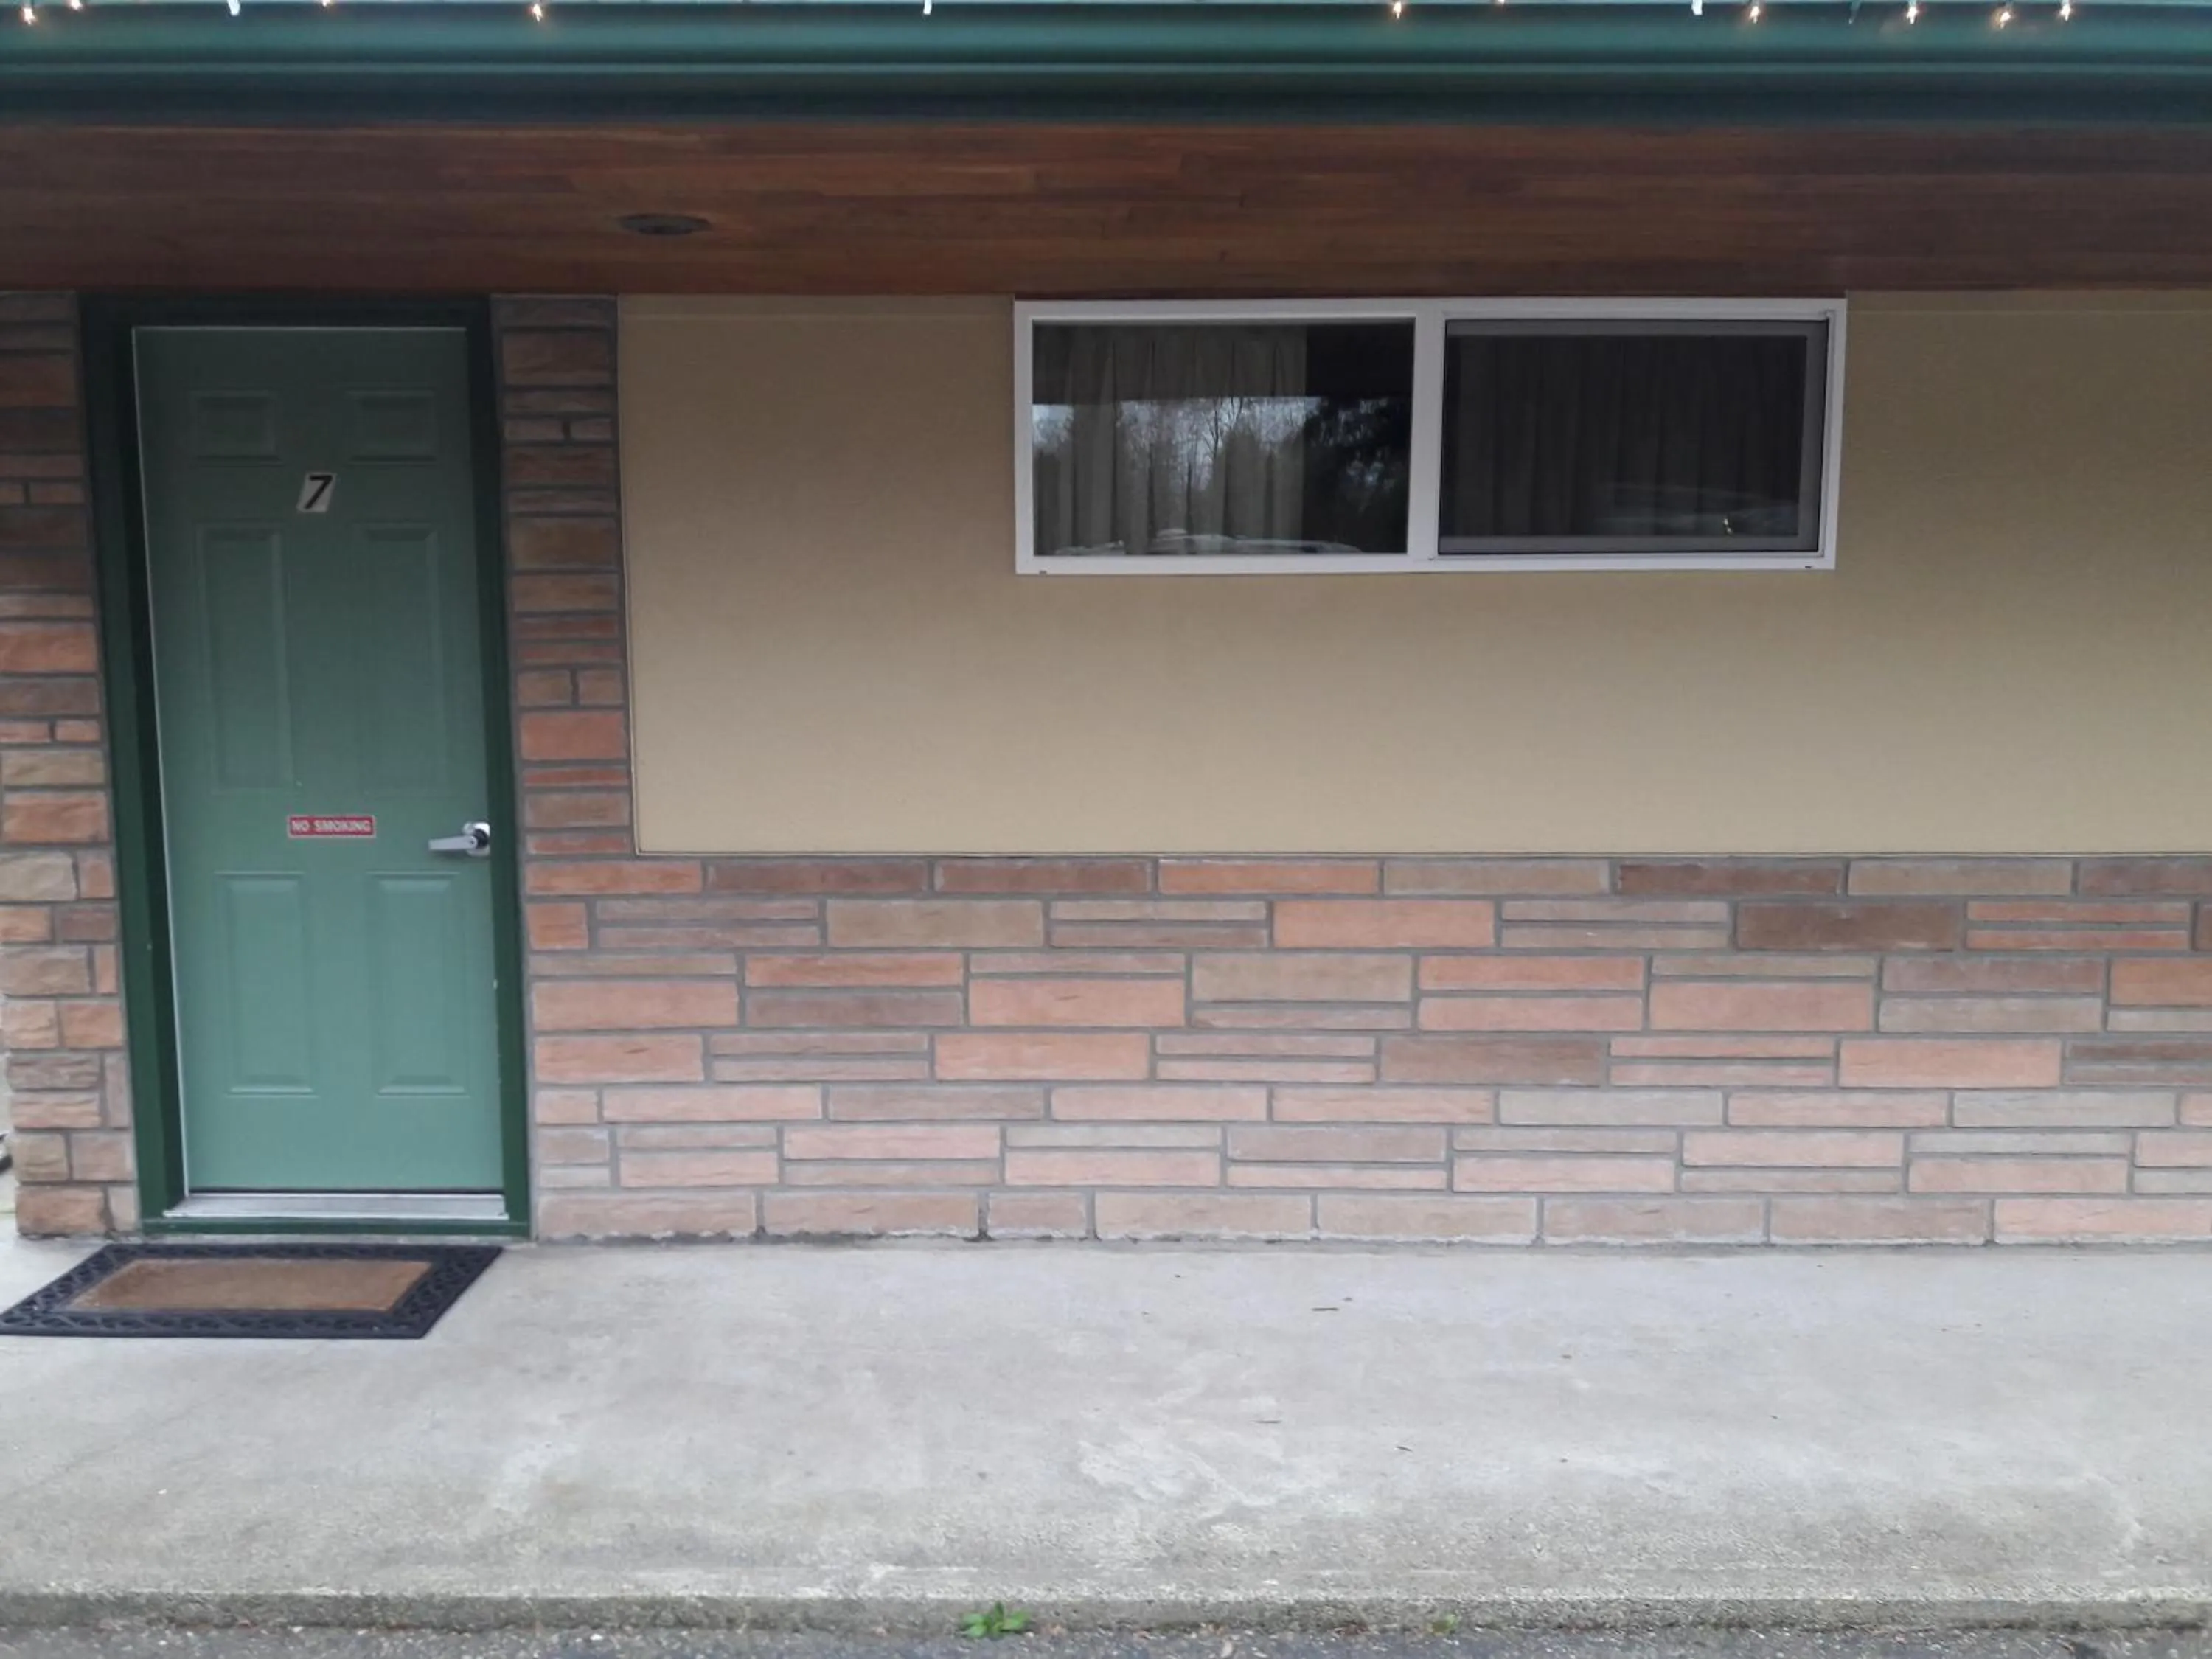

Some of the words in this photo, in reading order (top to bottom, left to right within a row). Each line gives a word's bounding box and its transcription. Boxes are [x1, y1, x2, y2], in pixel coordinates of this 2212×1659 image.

[304, 475, 333, 509] 7
[291, 819, 309, 832] NO
[314, 819, 372, 832] SMOKING
